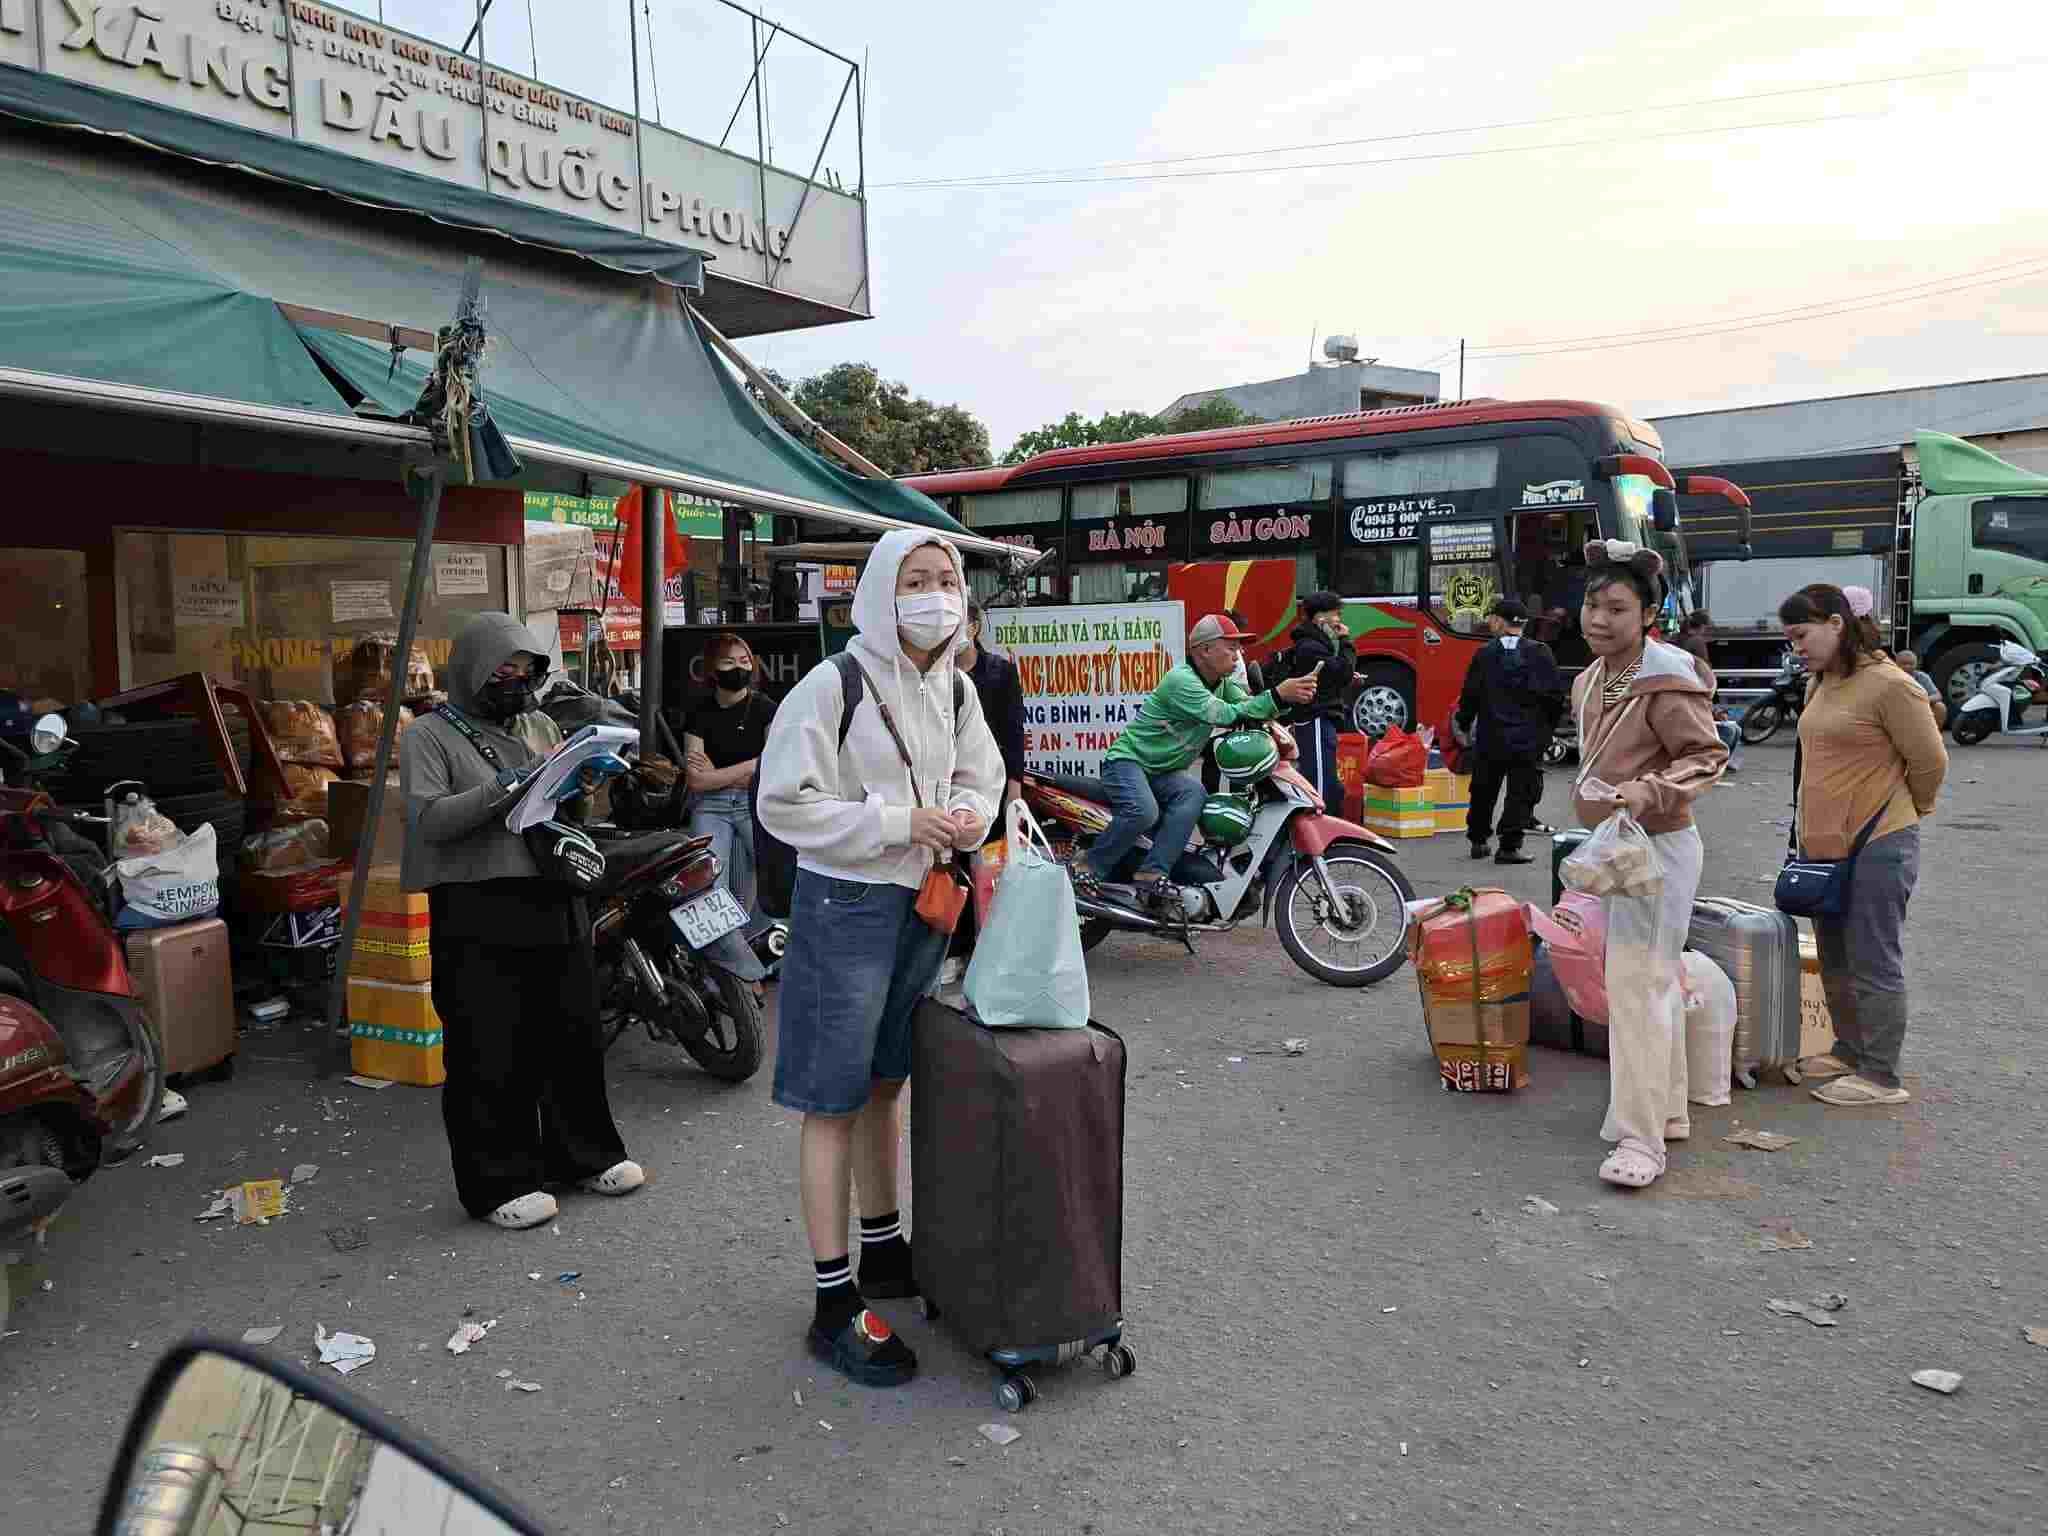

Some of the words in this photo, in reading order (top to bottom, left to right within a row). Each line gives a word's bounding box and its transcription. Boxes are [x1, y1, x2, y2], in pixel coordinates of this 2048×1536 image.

[60, 0, 289, 113] XĂNG
[319, 78, 457, 161] DẦU
[487, 133, 633, 212] QUỐC
[646, 178, 793, 264] PHONG
[1088, 520, 1121, 551] HÀ
[1124, 519, 1167, 555] NỘI
[1210, 511, 1252, 544] SÀI
[1255, 508, 1311, 540] GÒN
[1364, 527, 1394, 539] 0915
[995, 616, 1029, 645] ĐIỂM
[1032, 620, 1068, 647] NHẬN
[1072, 619, 1089, 642] VÀ
[1093, 617, 1120, 641] TRẢ
[1124, 616, 1161, 640] HÀNG
[1044, 653, 1091, 697] LONG
[1023, 704, 1046, 723] NG
[1050, 700, 1091, 723] BÌNH
[1105, 699, 1128, 722] HÀ
[1039, 732, 1061, 750] AN
